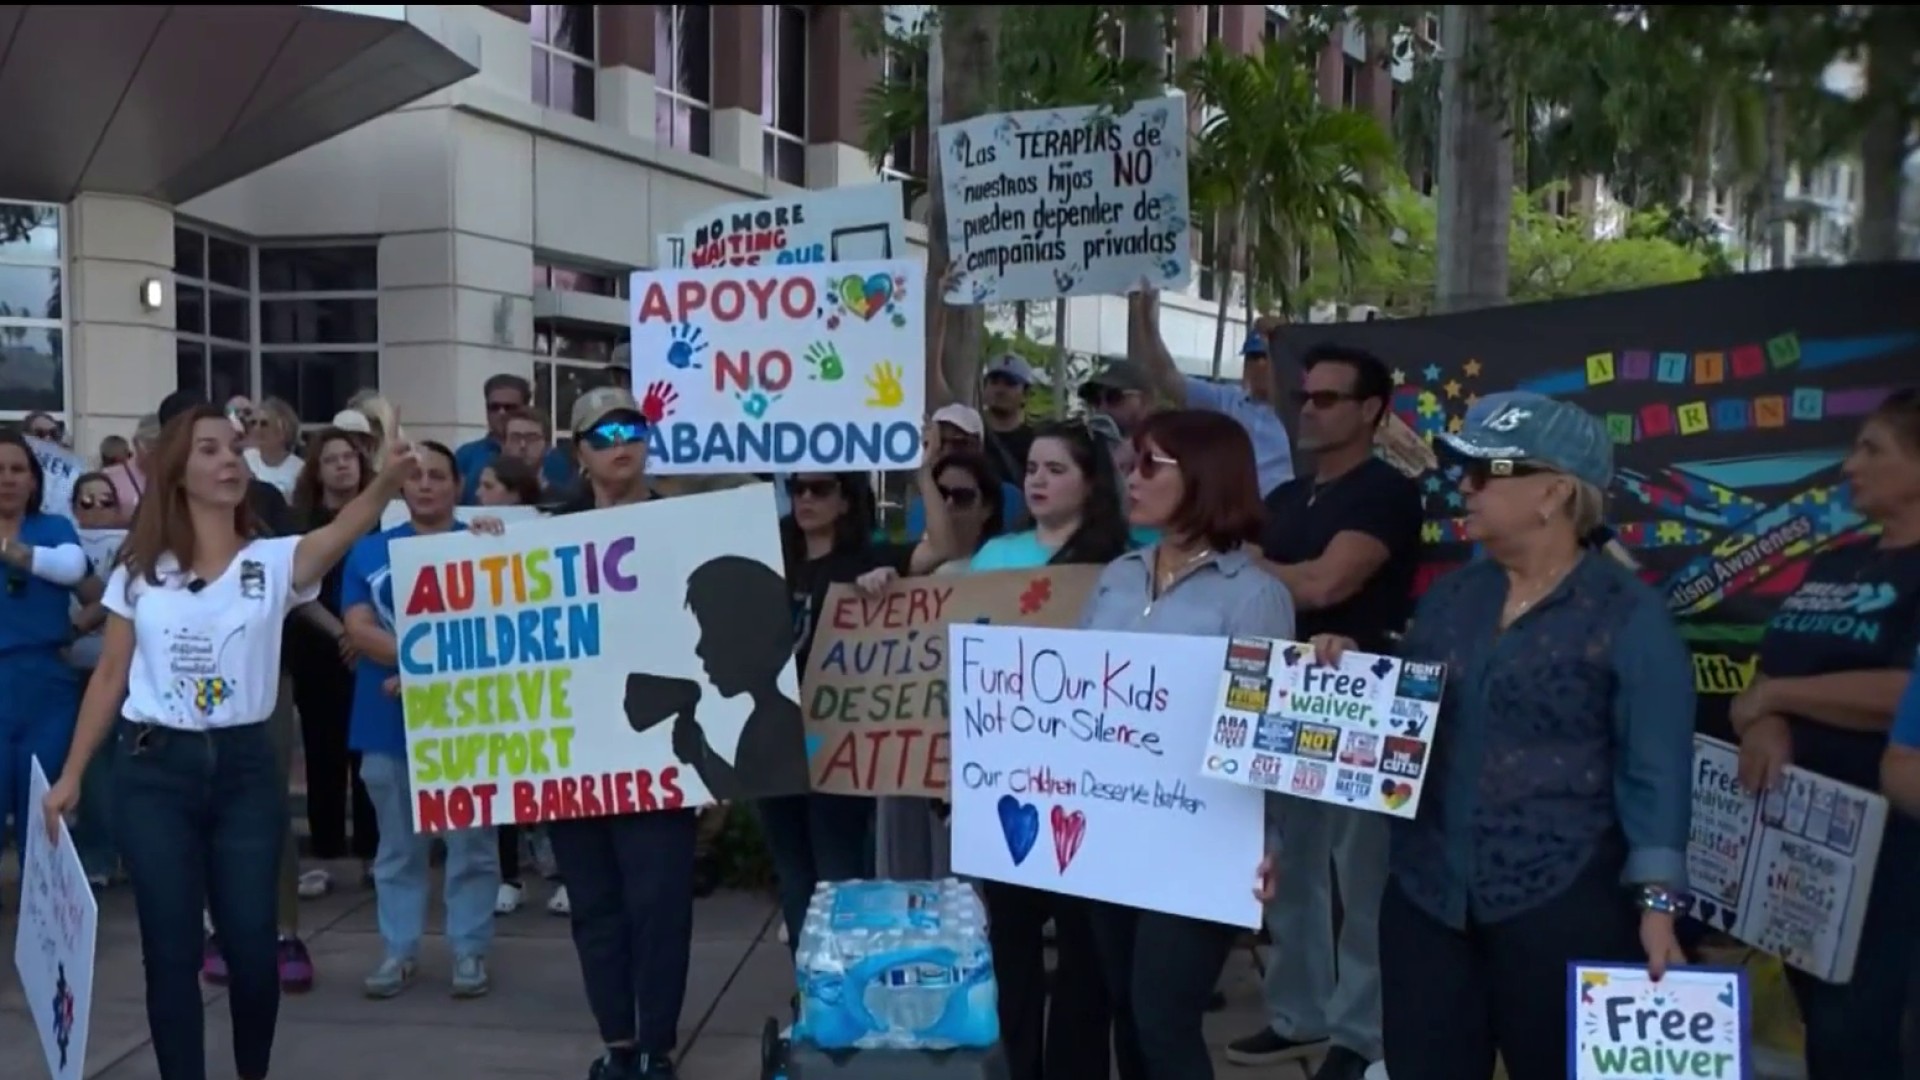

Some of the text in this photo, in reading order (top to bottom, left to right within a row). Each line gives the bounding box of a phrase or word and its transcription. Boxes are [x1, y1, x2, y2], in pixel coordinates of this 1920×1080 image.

[964, 121, 1162, 168] Las TERAPIAS de
[964, 148, 1152, 204] nuestros hijos NO
[695, 204, 805, 248] NO MORE
[963, 190, 1162, 252] pueden depender de
[692, 229, 787, 269] WAITING
[967, 225, 1177, 277] compañías privadas
[638, 276, 823, 323] APOYO,
[715, 350, 793, 392] NO
[646, 421, 920, 464] ABANDONO
[1713, 515, 1811, 582] Awareness
[406, 536, 638, 615] AUTISTIC
[833, 587, 953, 630] EVERY
[400, 602, 600, 675] CHILDREN
[962, 636, 1025, 700] Fund
[1031, 649, 1096, 705] Our
[1101, 650, 1170, 712] Kids
[1303, 663, 1367, 698] Free
[405, 667, 573, 731] DESERVE
[809, 679, 949, 723] DESER
[1291, 693, 1373, 722] waiver
[965, 705, 1164, 756] Not Our Silence
[1300, 731, 1337, 750] NOT
[413, 726, 575, 784] SUPPORT
[817, 729, 950, 790] ATTE
[963, 762, 1002, 790] Our
[1698, 758, 1740, 796] Free
[417, 766, 685, 833] NOT BARRIERS
[1606, 996, 1714, 1044] Free
[1592, 1040, 1734, 1078] waiver
